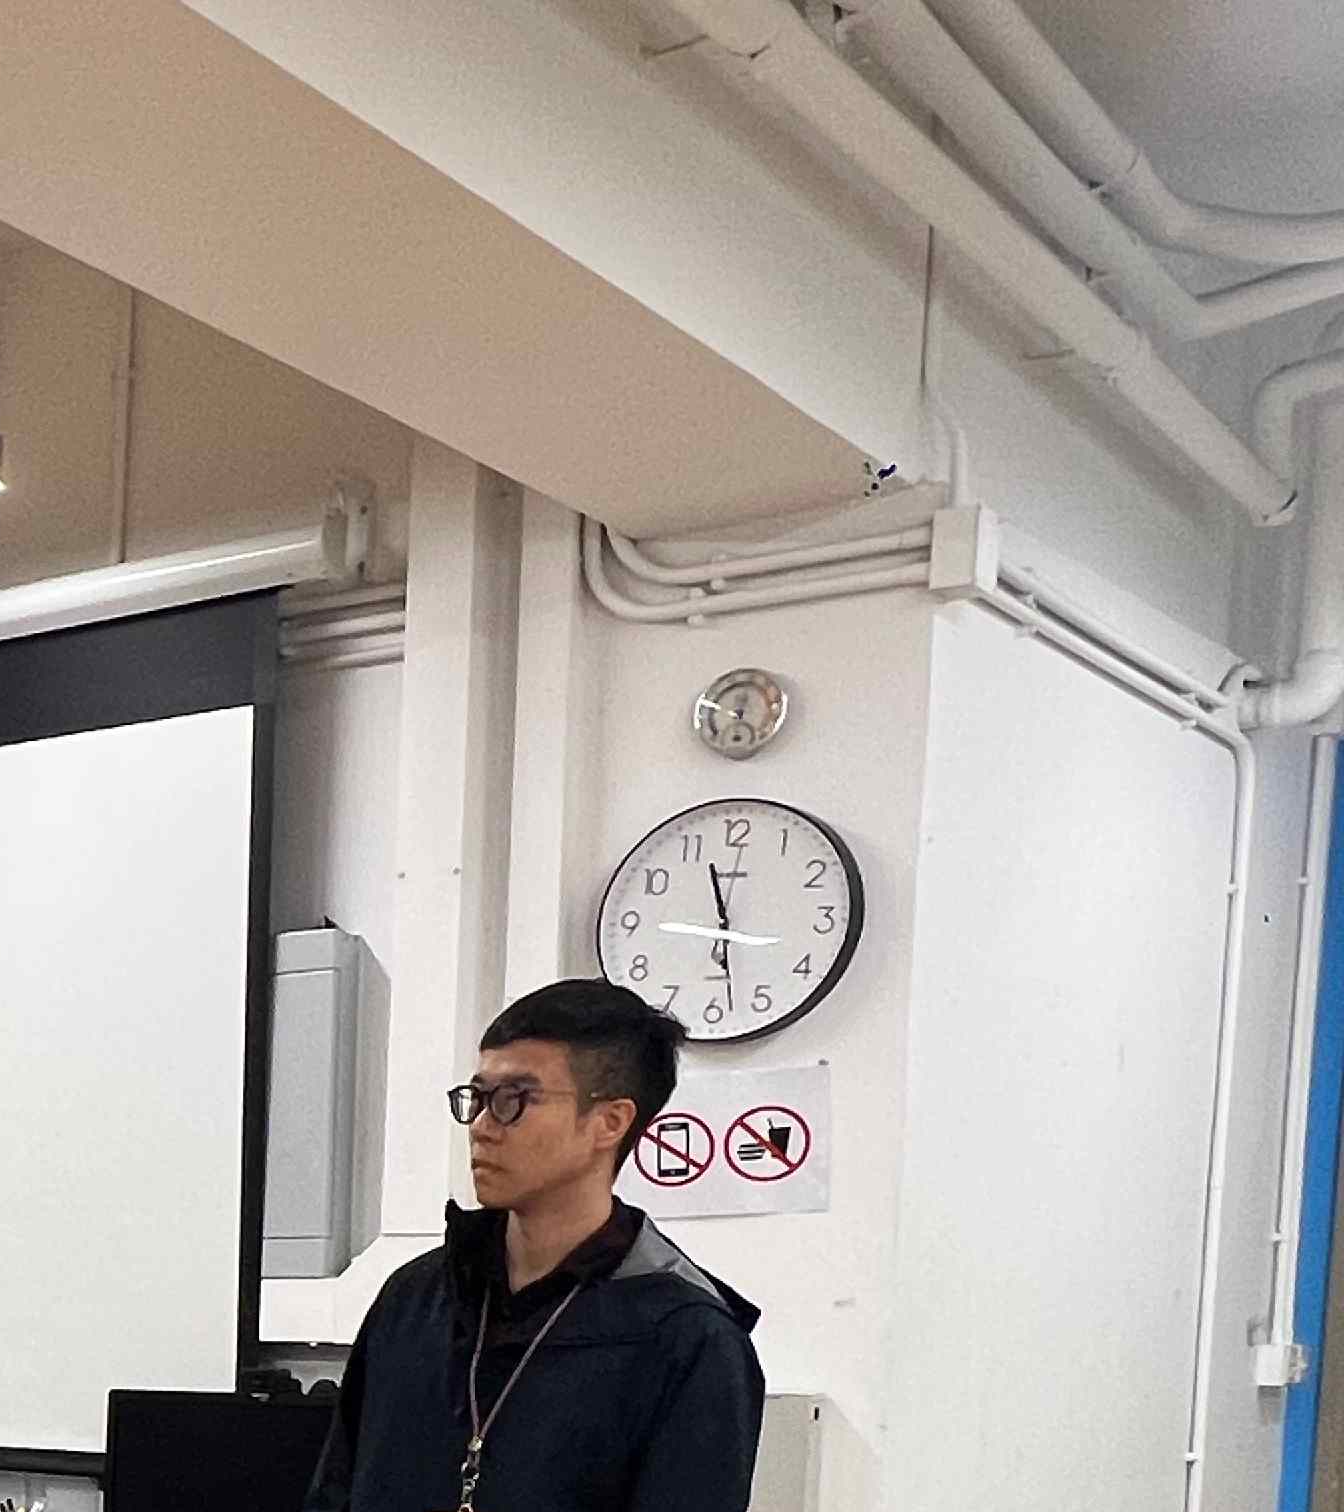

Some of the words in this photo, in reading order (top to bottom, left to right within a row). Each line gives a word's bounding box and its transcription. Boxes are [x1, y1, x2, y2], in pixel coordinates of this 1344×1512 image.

[724, 818, 751, 847] 12
[780, 828, 789, 856] 1
[681, 834, 702, 862] 11
[644, 868, 669, 895] 10
[803, 859, 827, 888] 2
[621, 910, 640, 937] 9
[812, 906, 835, 934] 3
[629, 954, 648, 981] 8
[792, 953, 812, 979] 4
[662, 985, 680, 1013] 7
[703, 997, 724, 1024] 6
[751, 985, 772, 1012] 5
